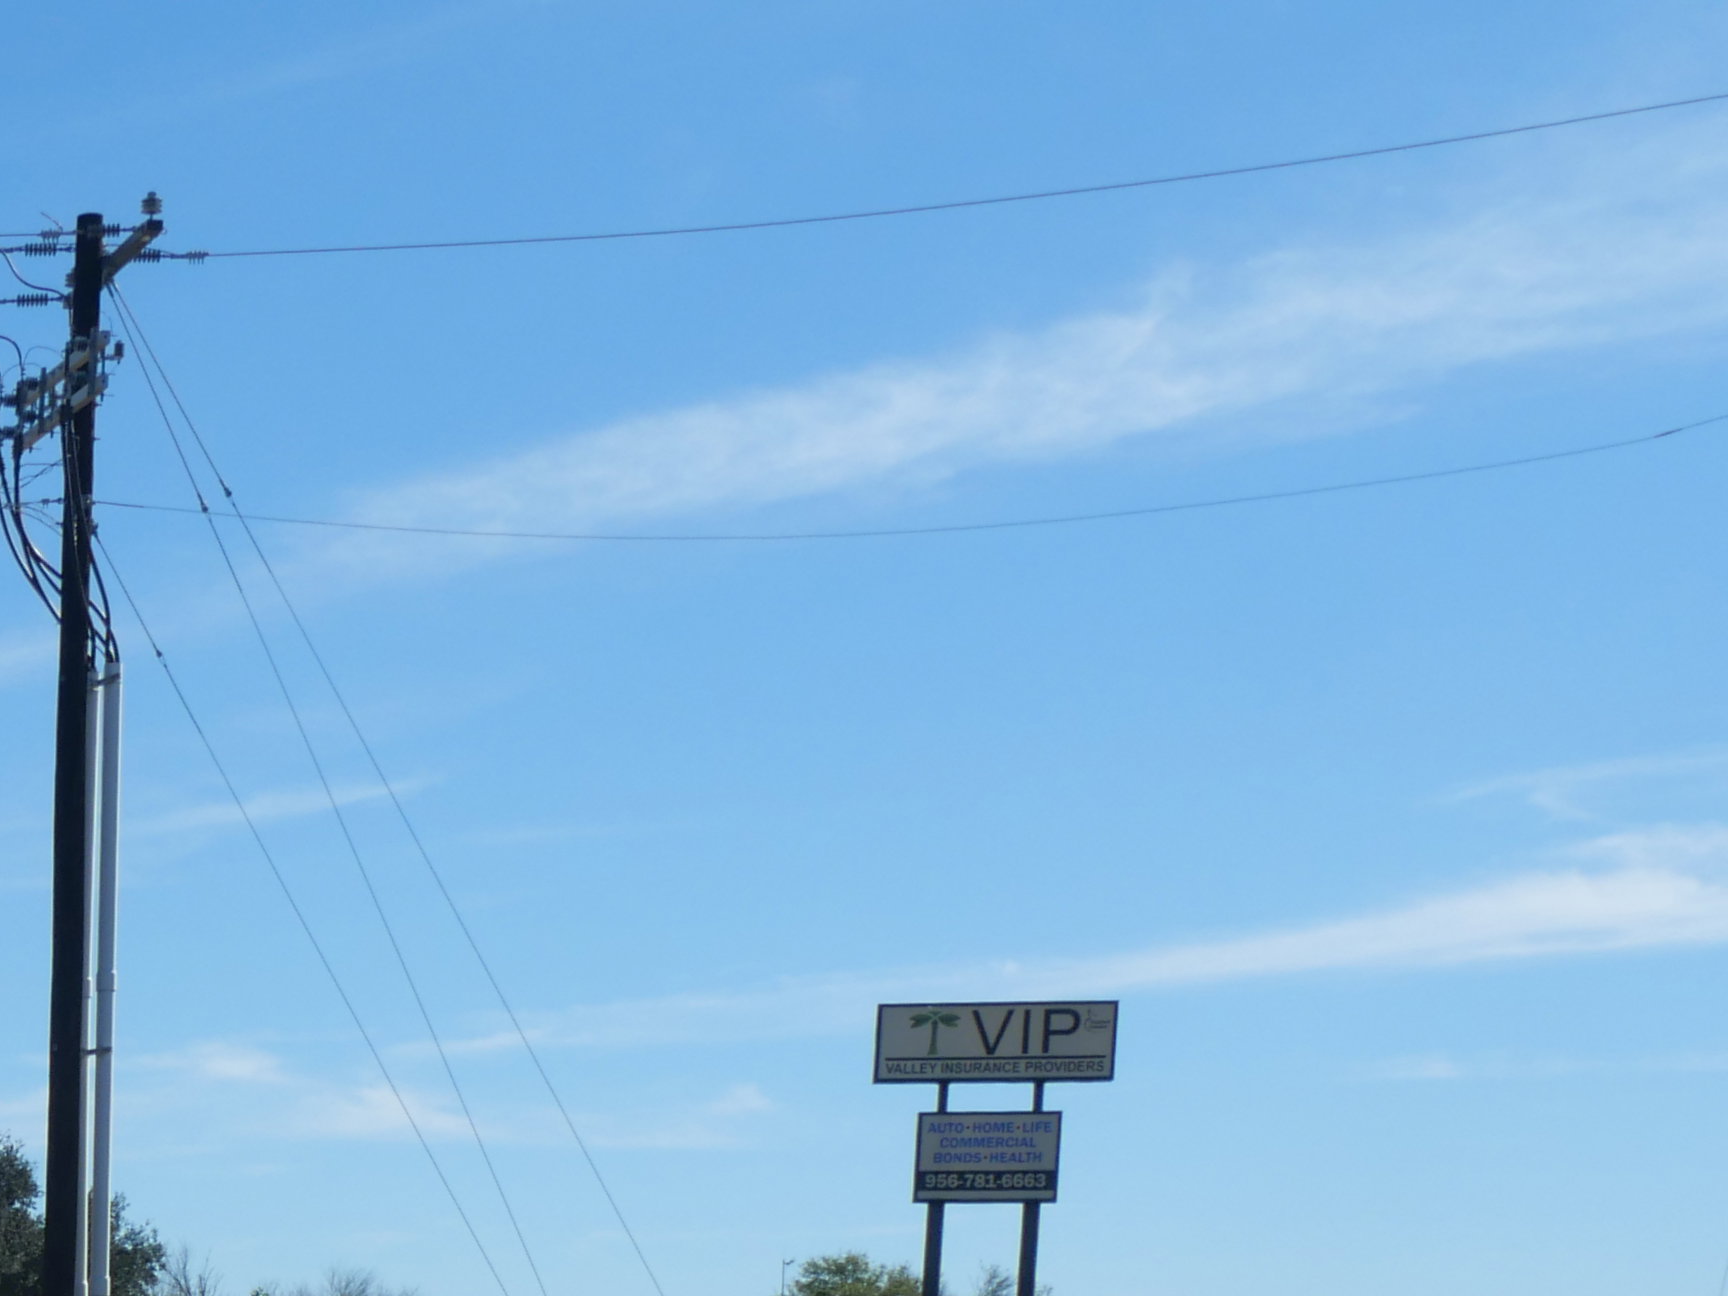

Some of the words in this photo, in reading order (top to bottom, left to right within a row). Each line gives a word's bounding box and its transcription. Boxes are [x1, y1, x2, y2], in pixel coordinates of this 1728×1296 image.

[972, 1008, 1081, 1055] VIP
[885, 1062, 937, 1075] VALLEY
[940, 1061, 1020, 1074] INSURANCE
[1024, 1060, 1105, 1073] PROVIDERS
[928, 1122, 963, 1133] AUTO
[972, 1121, 1015, 1133] HOME
[1021, 1121, 1052, 1133] LIFE
[939, 1136, 1037, 1148] COMMERCIAL
[932, 1152, 982, 1163] BONDS
[989, 1151, 1043, 1163] HEALTH
[925, 1173, 1047, 1188] 956-781-6663
